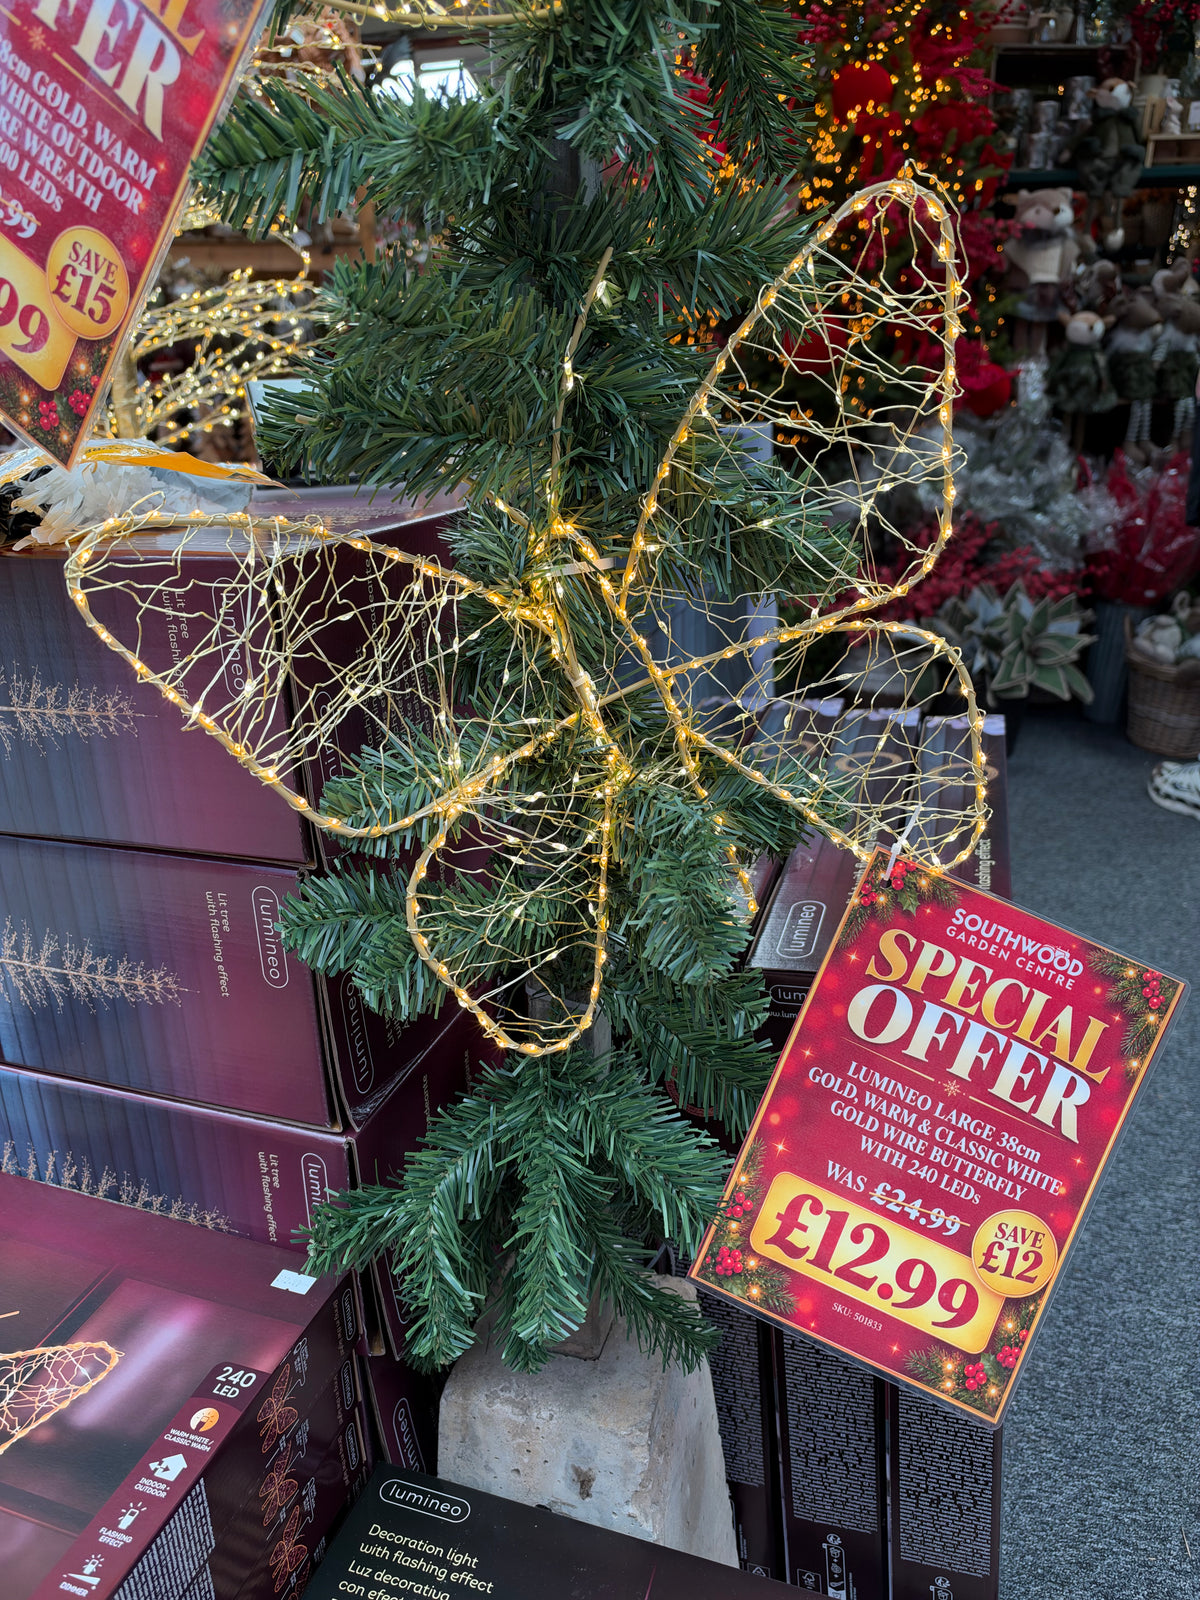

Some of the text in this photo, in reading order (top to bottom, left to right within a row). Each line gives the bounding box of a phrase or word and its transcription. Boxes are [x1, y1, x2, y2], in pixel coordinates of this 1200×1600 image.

[32, 70, 88, 138] GOLD,
[94, 121, 158, 191] WARM
[18, 160, 64, 212] LEDs
[24, 127, 104, 214] WREATH
[51, 122, 143, 215] OUTDOOR
[68, 241, 119, 285] SAVE
[52, 263, 117, 325] £15
[174, 590, 187, 608] Lit
[217, 892, 231, 933] Lit tree
[784, 905, 817, 952] lumineo
[205, 890, 230, 998] with flashing effect
[258, 897, 281, 979] lumineo
[946, 926, 1076, 990] GARDEN CENTRE
[952, 908, 1084, 977] SOUTHWOOD
[865, 928, 1111, 1084] SPECIAL
[346, 981, 369, 1083] lumineo
[847, 984, 1091, 1144] OFFER
[808, 1066, 1063, 1196] GOLD, WARM & CLASSIC WHITE
[847, 1061, 1042, 1164] LUMINEO LARGE 38cm
[270, 1153, 281, 1188] Lit tree
[830, 1100, 1028, 1202] GOLD WIRE BUTTERFLY
[860, 1135, 981, 1205] WITH 240 LEDs
[258, 1151, 278, 1242] with flashing effect
[826, 1160, 961, 1236] WAS £24.99
[994, 1222, 1046, 1250] SAVE
[765, 1193, 980, 1329] £12.99
[978, 1240, 1044, 1284] £12
[832, 1302, 882, 1332] SKU: 501833
[212, 1383, 240, 1398] LED
[216, 1366, 257, 1388] 240
[164, 1433, 191, 1446] CLASSIC
[169, 1428, 190, 1440] WARM
[189, 1433, 210, 1445] WHITE
[134, 1483, 167, 1498] OUTDOOR
[139, 1477, 167, 1490] INDOOR
[389, 1484, 462, 1516] lumineo
[98, 1535, 124, 1548] EFFECT
[99, 1527, 133, 1543] FLASHING
[368, 1523, 479, 1568] Decoration light
[59, 1581, 89, 1597] DIMMER
[338, 1580, 366, 1597] con
[348, 1559, 450, 1600] Luz decorativa
[359, 1542, 494, 1594] with flashing effect
